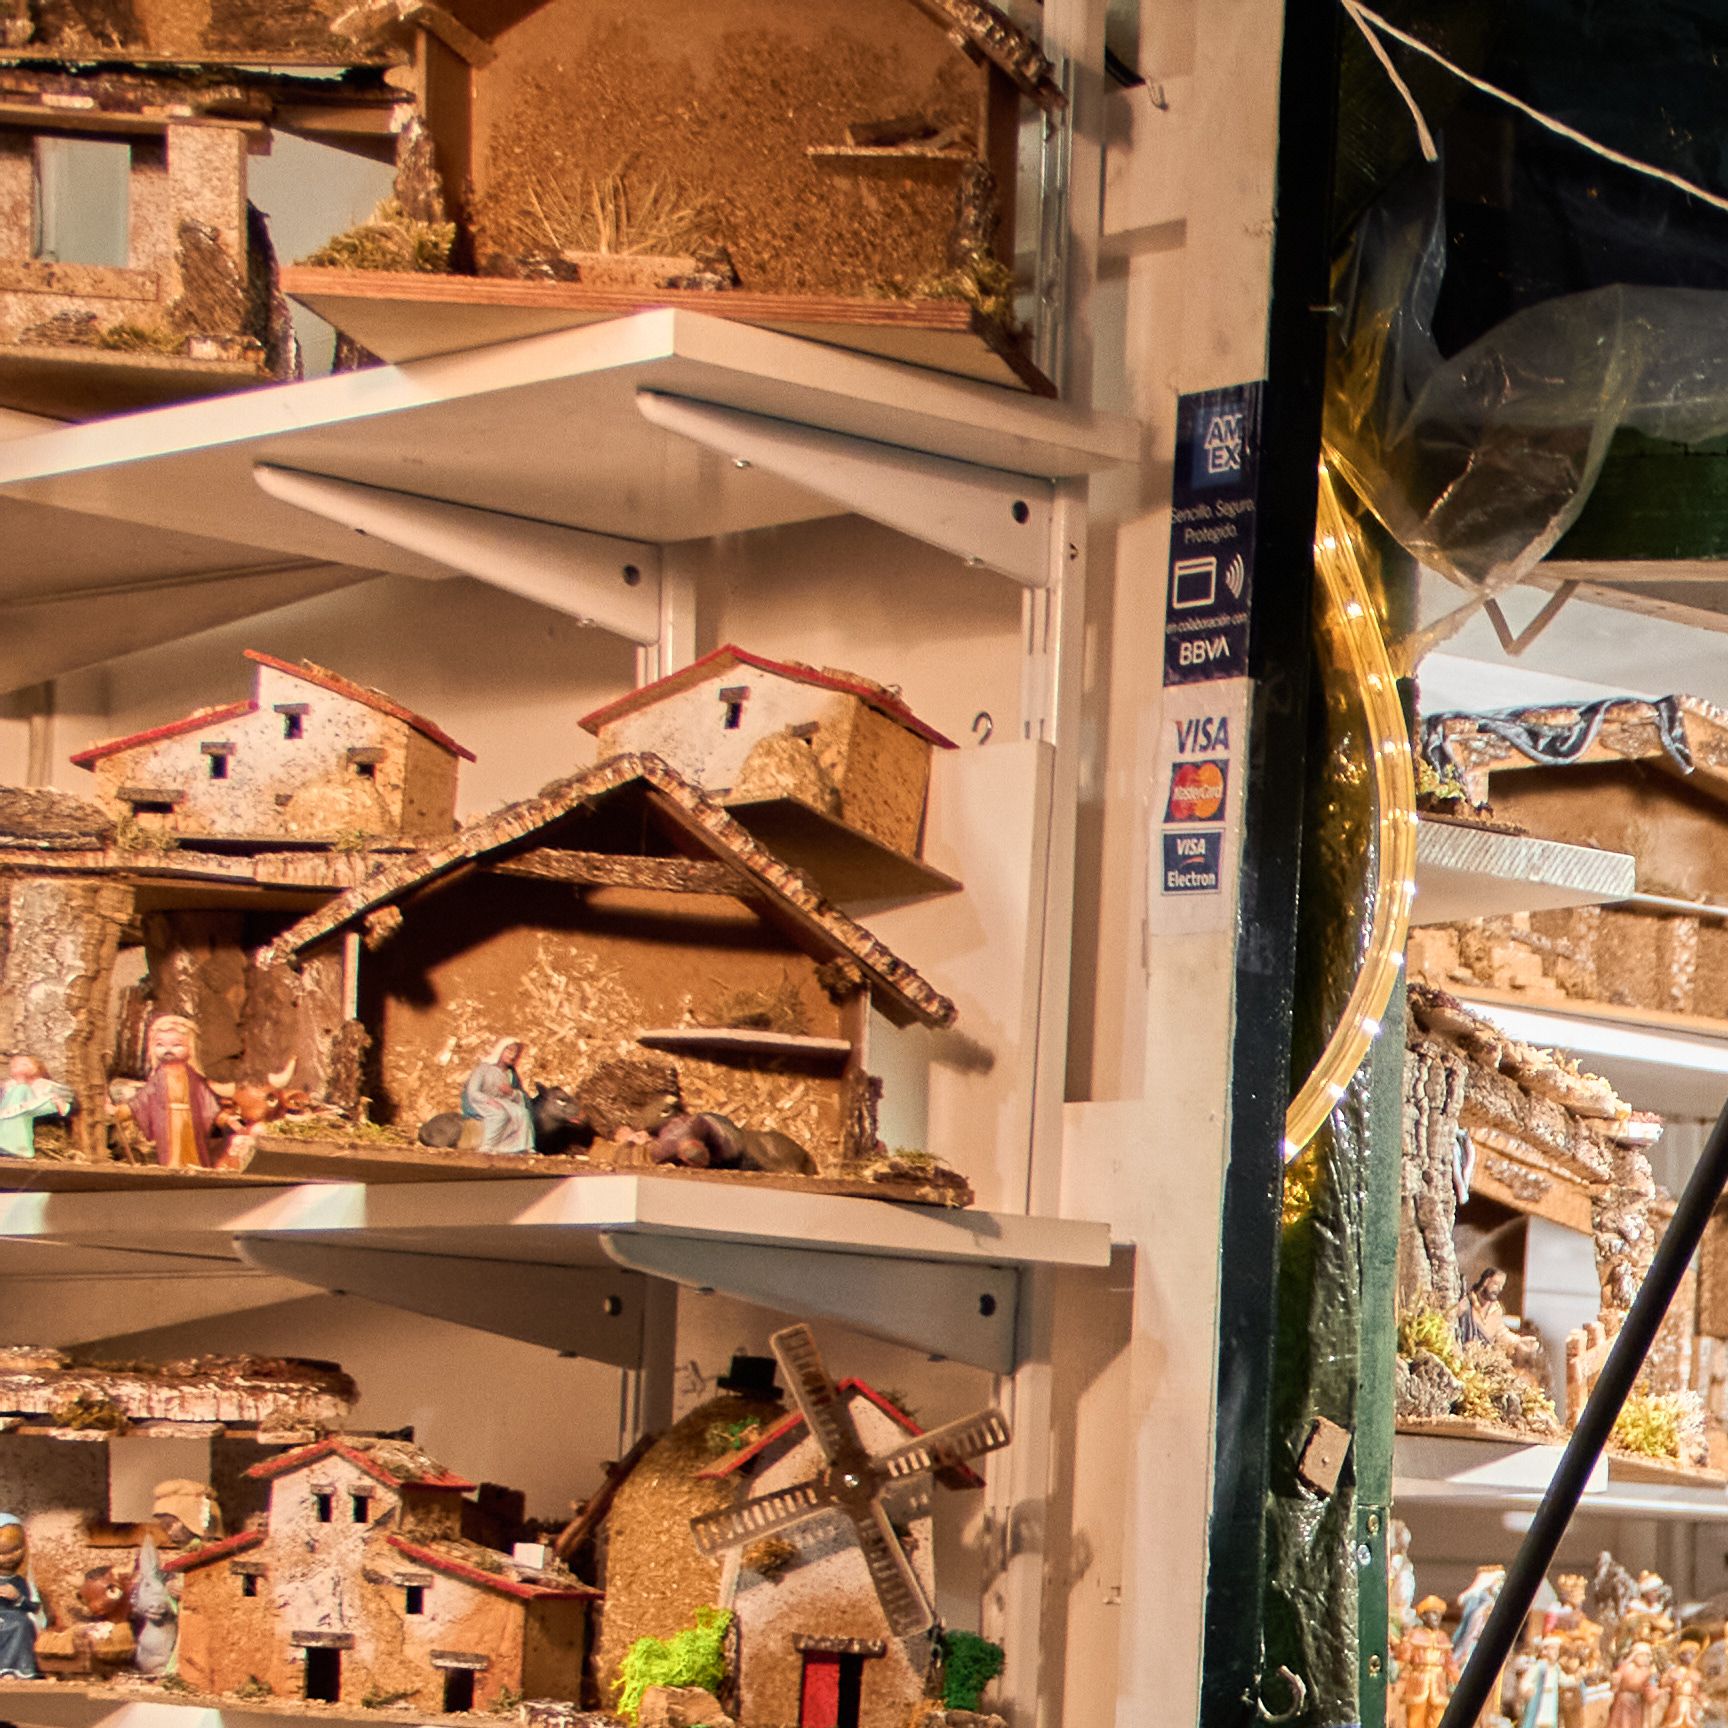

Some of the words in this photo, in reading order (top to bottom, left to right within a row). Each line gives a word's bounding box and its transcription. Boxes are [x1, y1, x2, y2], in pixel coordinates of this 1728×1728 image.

[1179, 635, 1230, 666] BBVA
[1176, 716, 1230, 754] VISA
[1173, 784, 1221, 801] MasterCard
[1176, 838, 1206, 855] VISA
[1167, 871, 1216, 887] Electron
